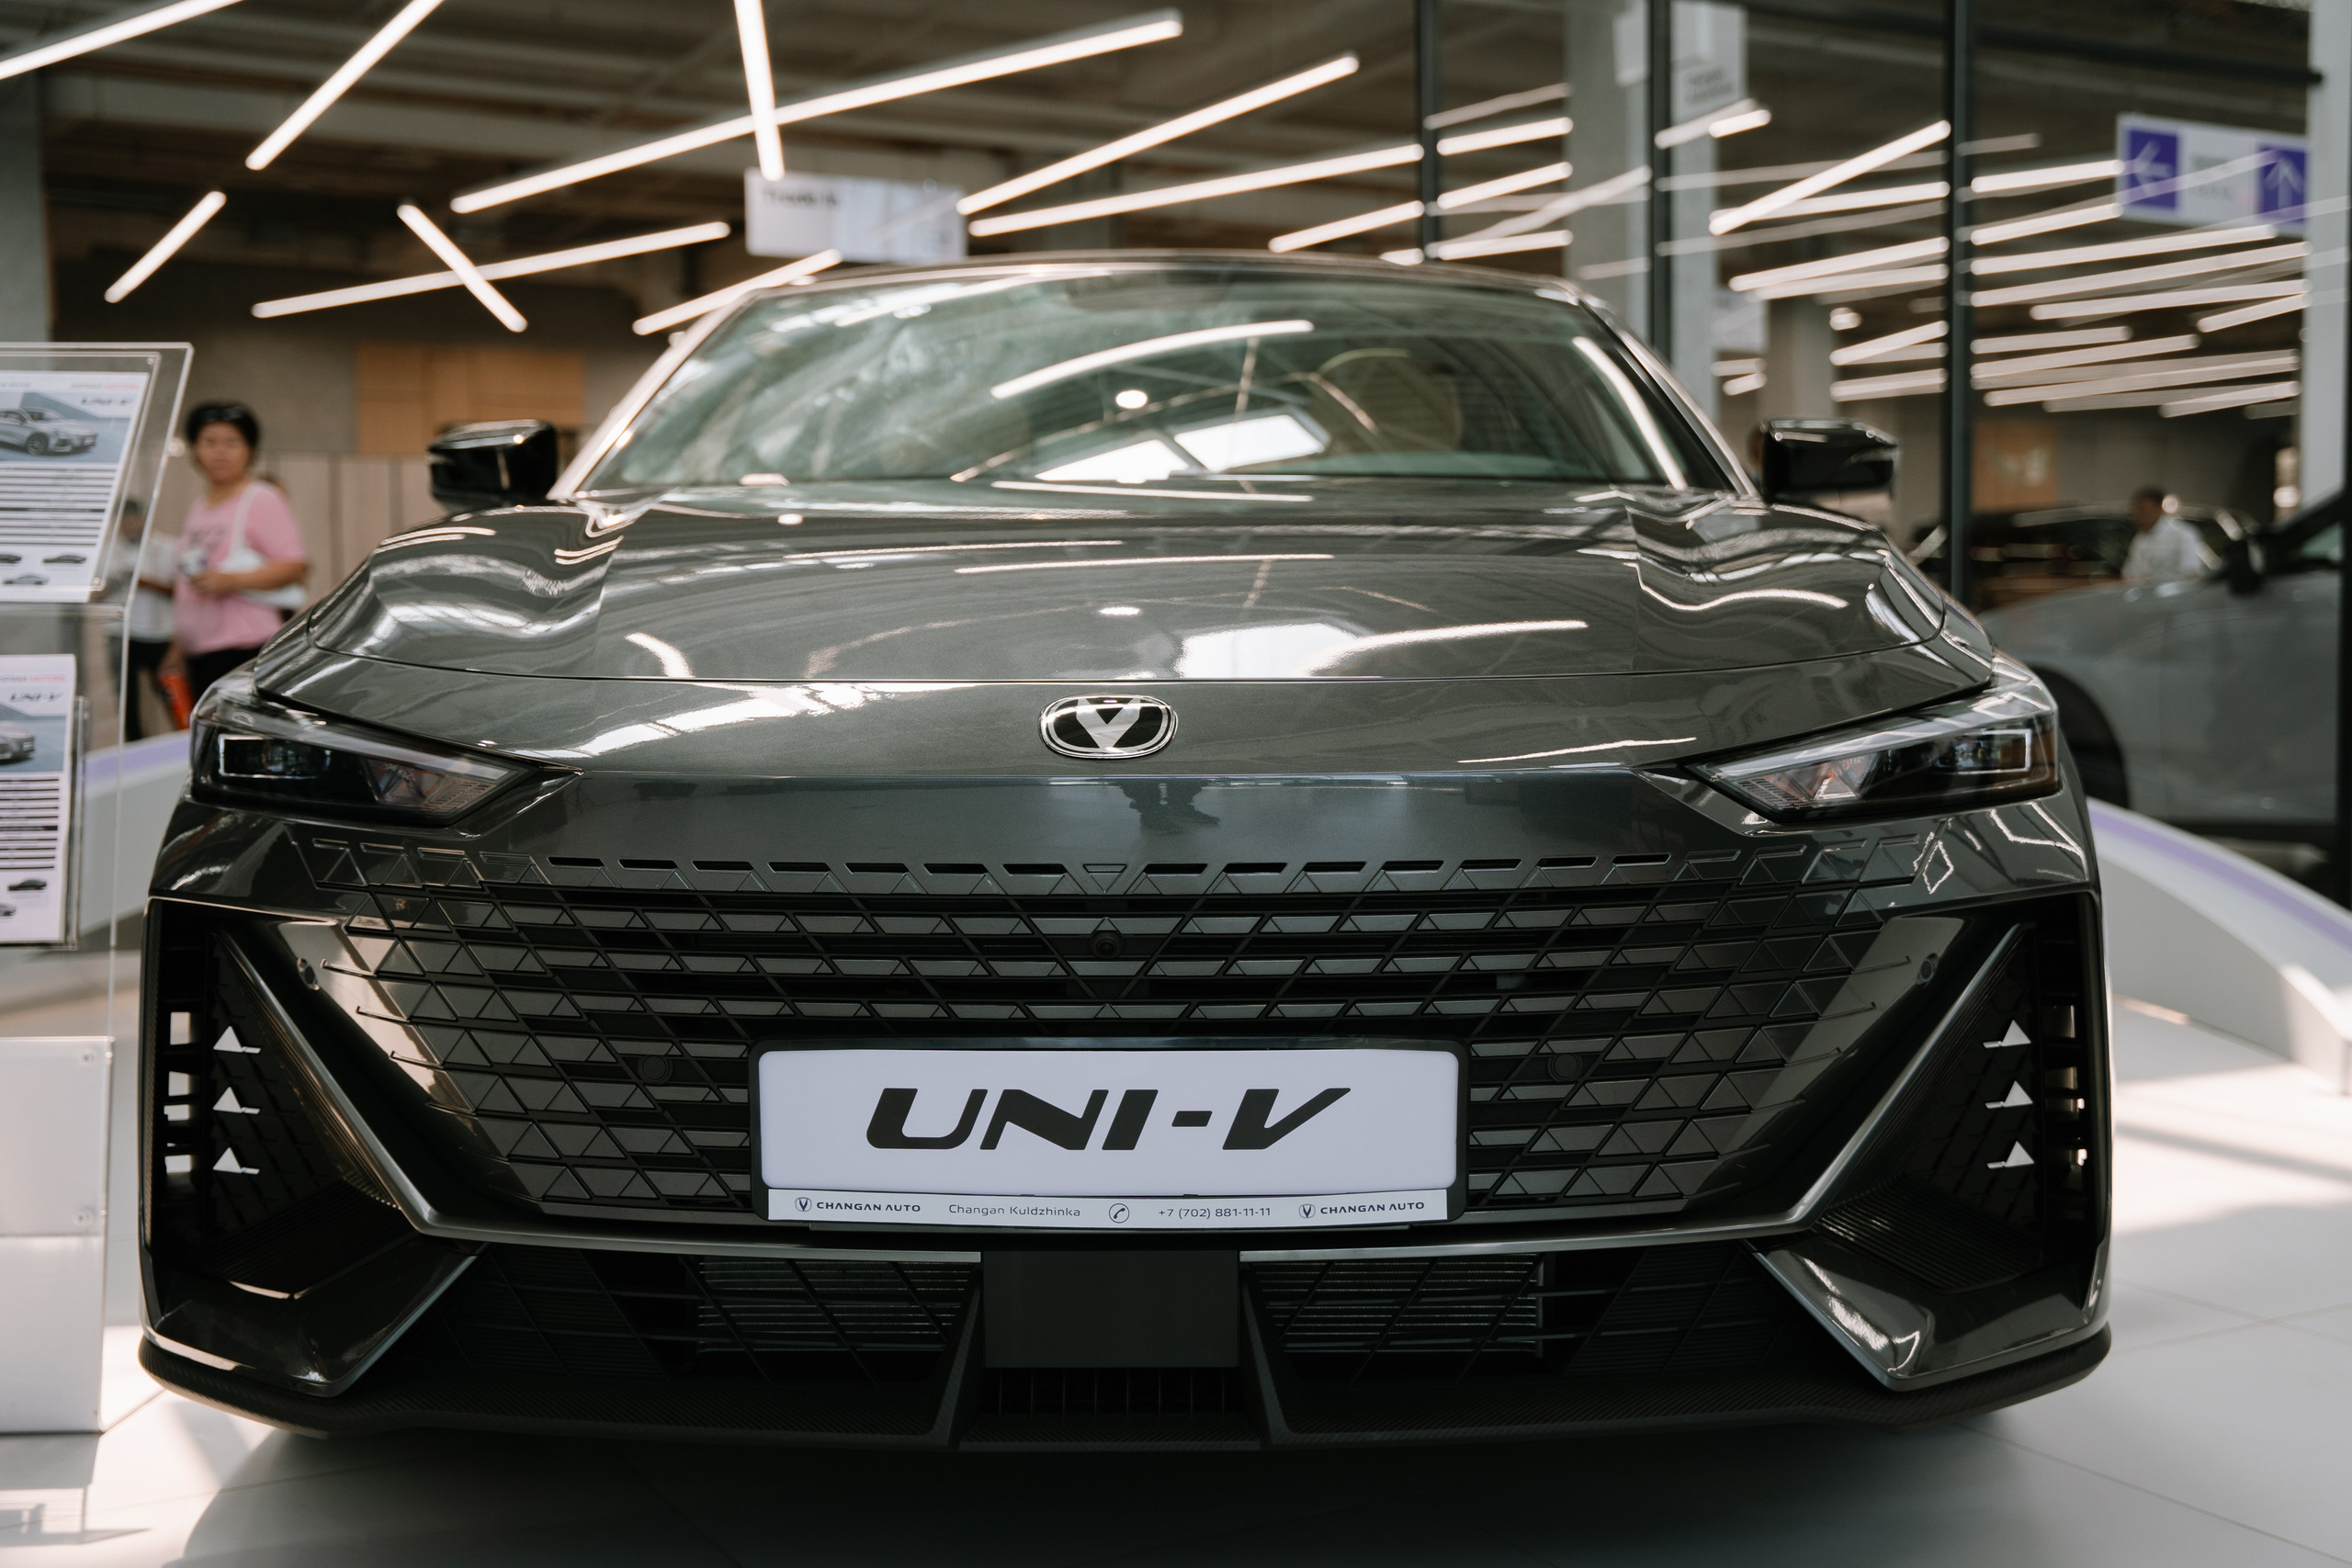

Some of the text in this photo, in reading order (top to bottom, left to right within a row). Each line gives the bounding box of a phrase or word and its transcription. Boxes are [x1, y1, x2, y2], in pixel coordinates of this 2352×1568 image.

[865, 1088, 1351, 1151] UNI-V
[816, 1201, 921, 1213] CHANGAN AUTO
[948, 1204, 1080, 1217] Changan Kuldzhinka
[1159, 1207, 1272, 1220] +7 (702) 881-11-11
[1320, 1201, 1425, 1214] CHANGAN AUTO
